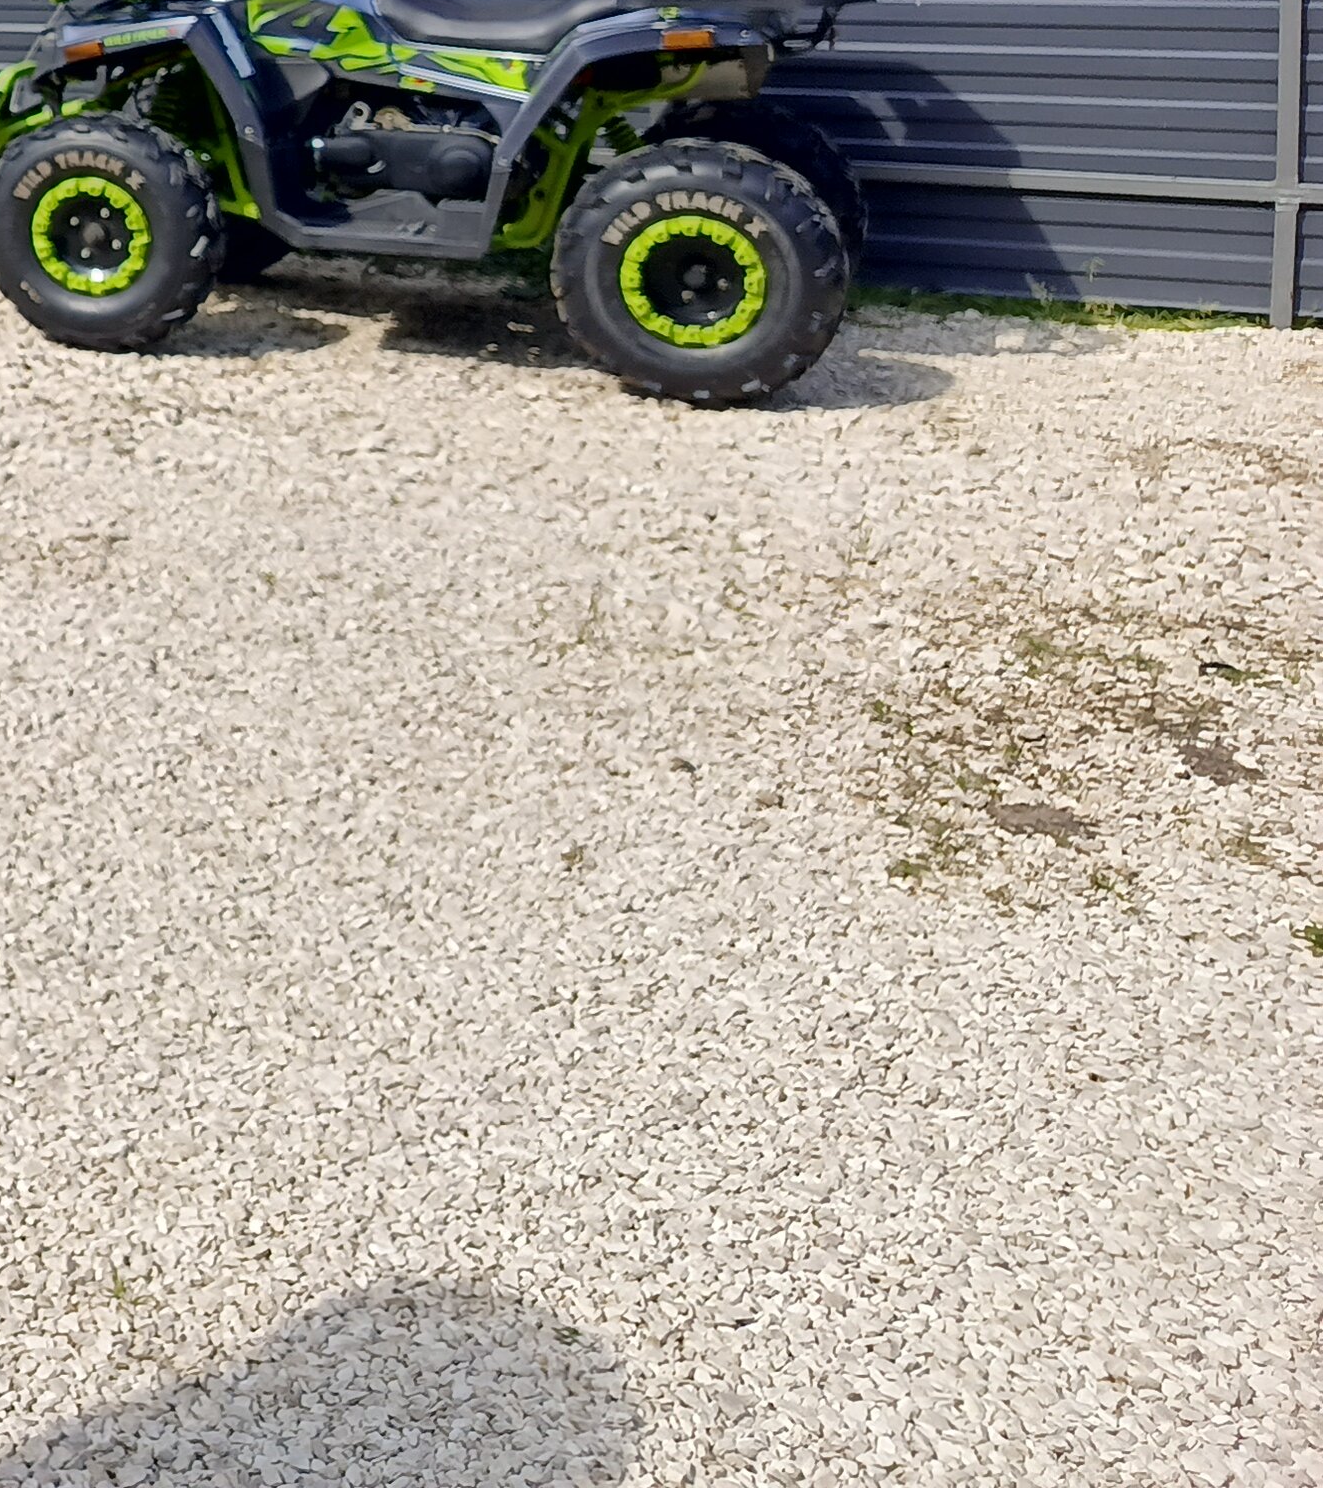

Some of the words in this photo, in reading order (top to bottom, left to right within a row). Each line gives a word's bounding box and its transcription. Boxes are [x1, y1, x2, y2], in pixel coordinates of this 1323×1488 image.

[13, 160, 52, 199] WILD
[54, 150, 125, 176] TRACK
[601, 201, 651, 246] WILD
[655, 190, 746, 222] TRACK
